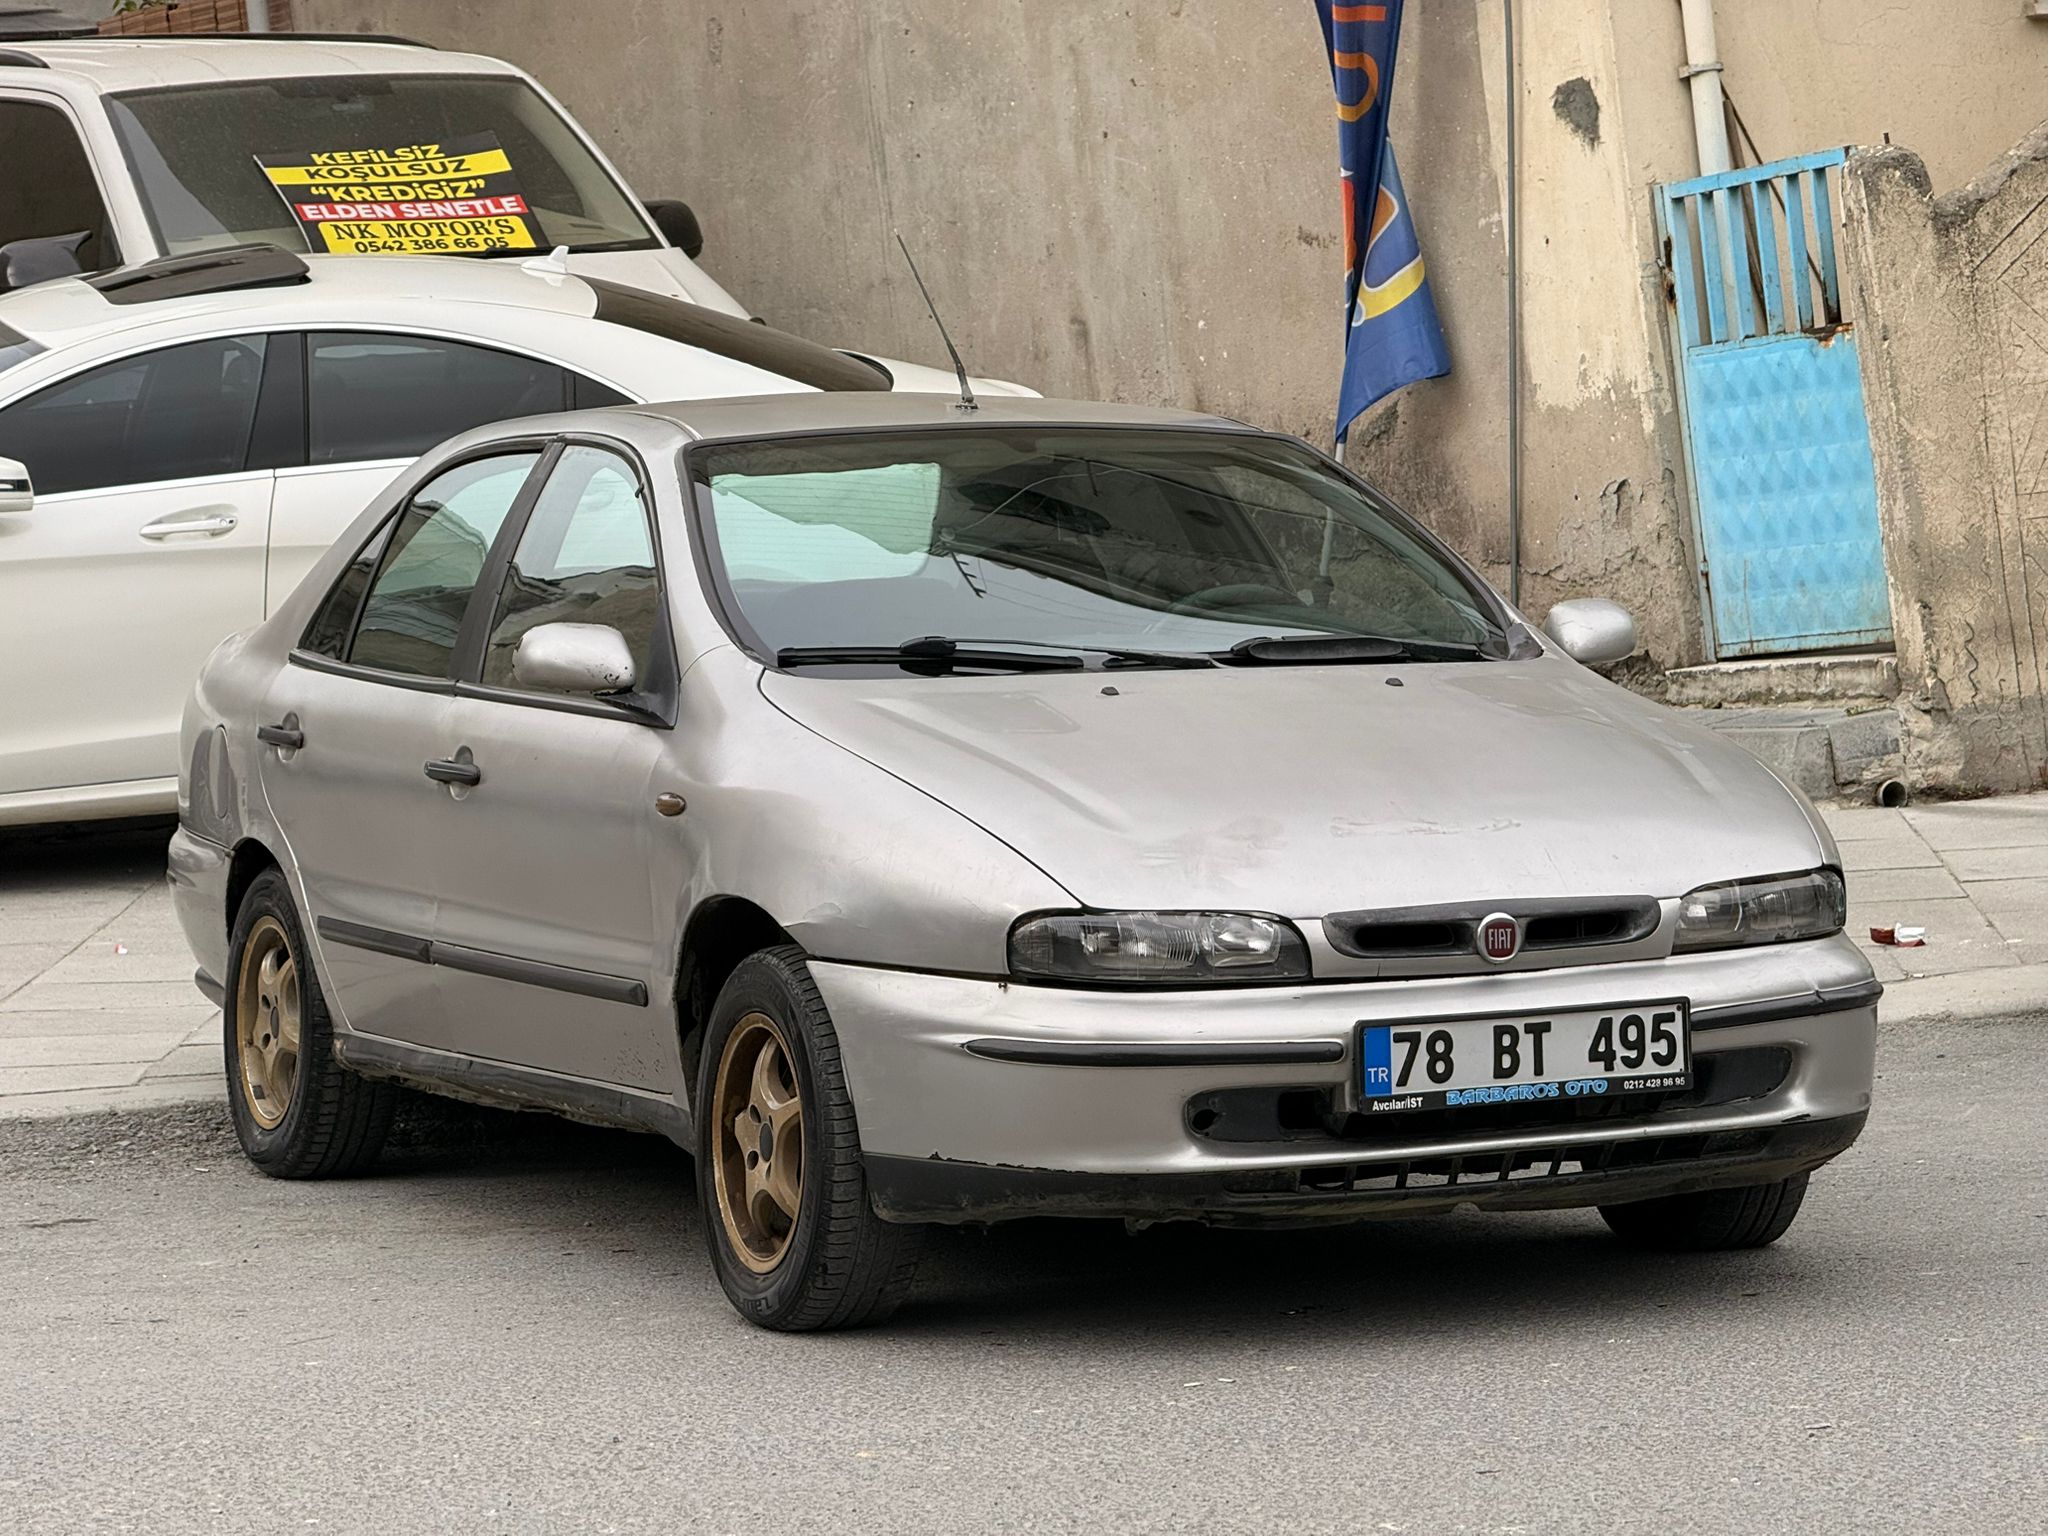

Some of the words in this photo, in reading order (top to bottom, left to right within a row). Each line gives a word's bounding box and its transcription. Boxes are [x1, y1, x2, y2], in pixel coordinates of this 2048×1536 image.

[304, 158, 471, 182] KOŞULSUZ
[301, 203, 396, 220] ELDEN
[399, 196, 522, 218] SENETLE
[330, 223, 379, 240] NK
[354, 240, 407, 254] 0542
[411, 237, 449, 250] 386
[452, 235, 480, 249] 66
[483, 235, 510, 249] 05
[1488, 928, 1512, 949] FIAT
[1393, 1029, 1454, 1087] 78
[1493, 1021, 1552, 1079] BT
[1588, 1011, 1678, 1072] 495
[1367, 1067, 1389, 1084] TR
[1623, 1080, 1645, 1090] 0212
[1446, 1082, 1560, 1105] BARBAROS
[1565, 1079, 1608, 1095] OTO
